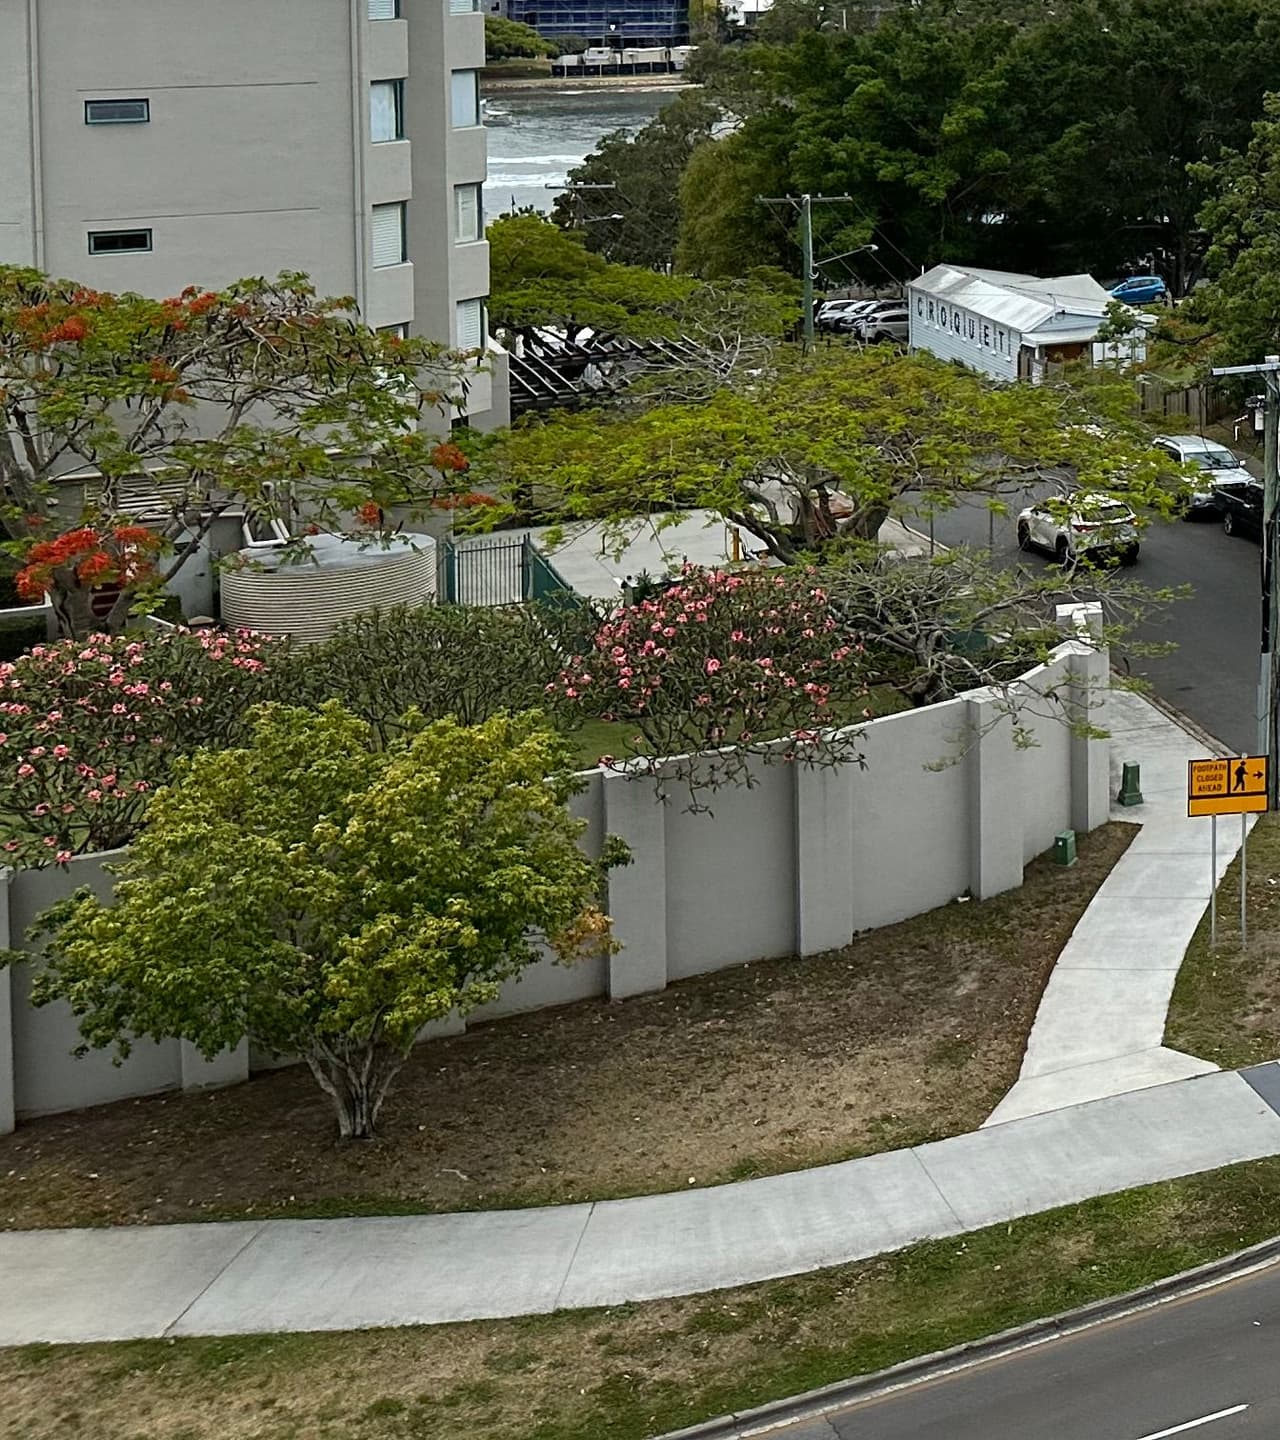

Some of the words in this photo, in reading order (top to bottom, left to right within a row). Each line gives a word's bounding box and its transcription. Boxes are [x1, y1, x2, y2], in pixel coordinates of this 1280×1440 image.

[917, 296, 1005, 353] CROQUET
[1193, 764, 1227, 773] FOOTPATH
[1196, 773, 1224, 783] CLOSED
[1197, 783, 1222, 792] AHEAD
